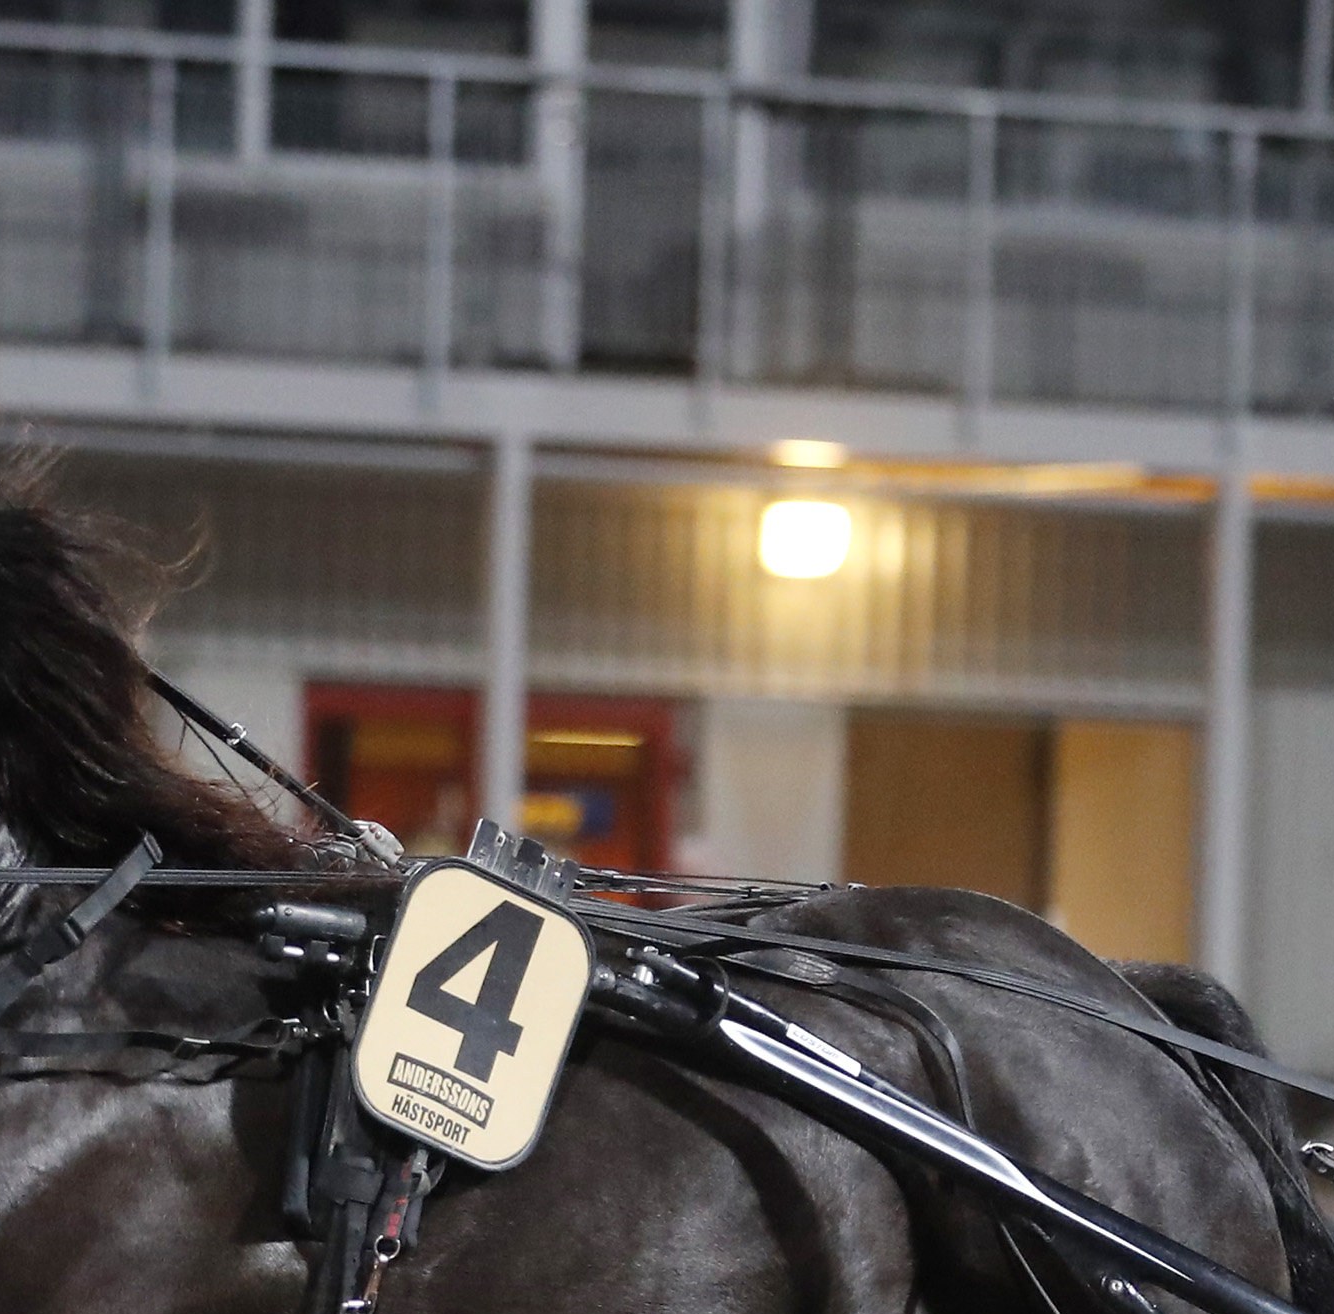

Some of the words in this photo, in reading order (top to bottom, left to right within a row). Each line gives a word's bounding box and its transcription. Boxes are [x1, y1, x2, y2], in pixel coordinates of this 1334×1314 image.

[406, 900, 545, 1084] 4
[392, 1094, 471, 1145] HÄSTSPORT
[393, 1058, 491, 1124] ANDERSSONS
